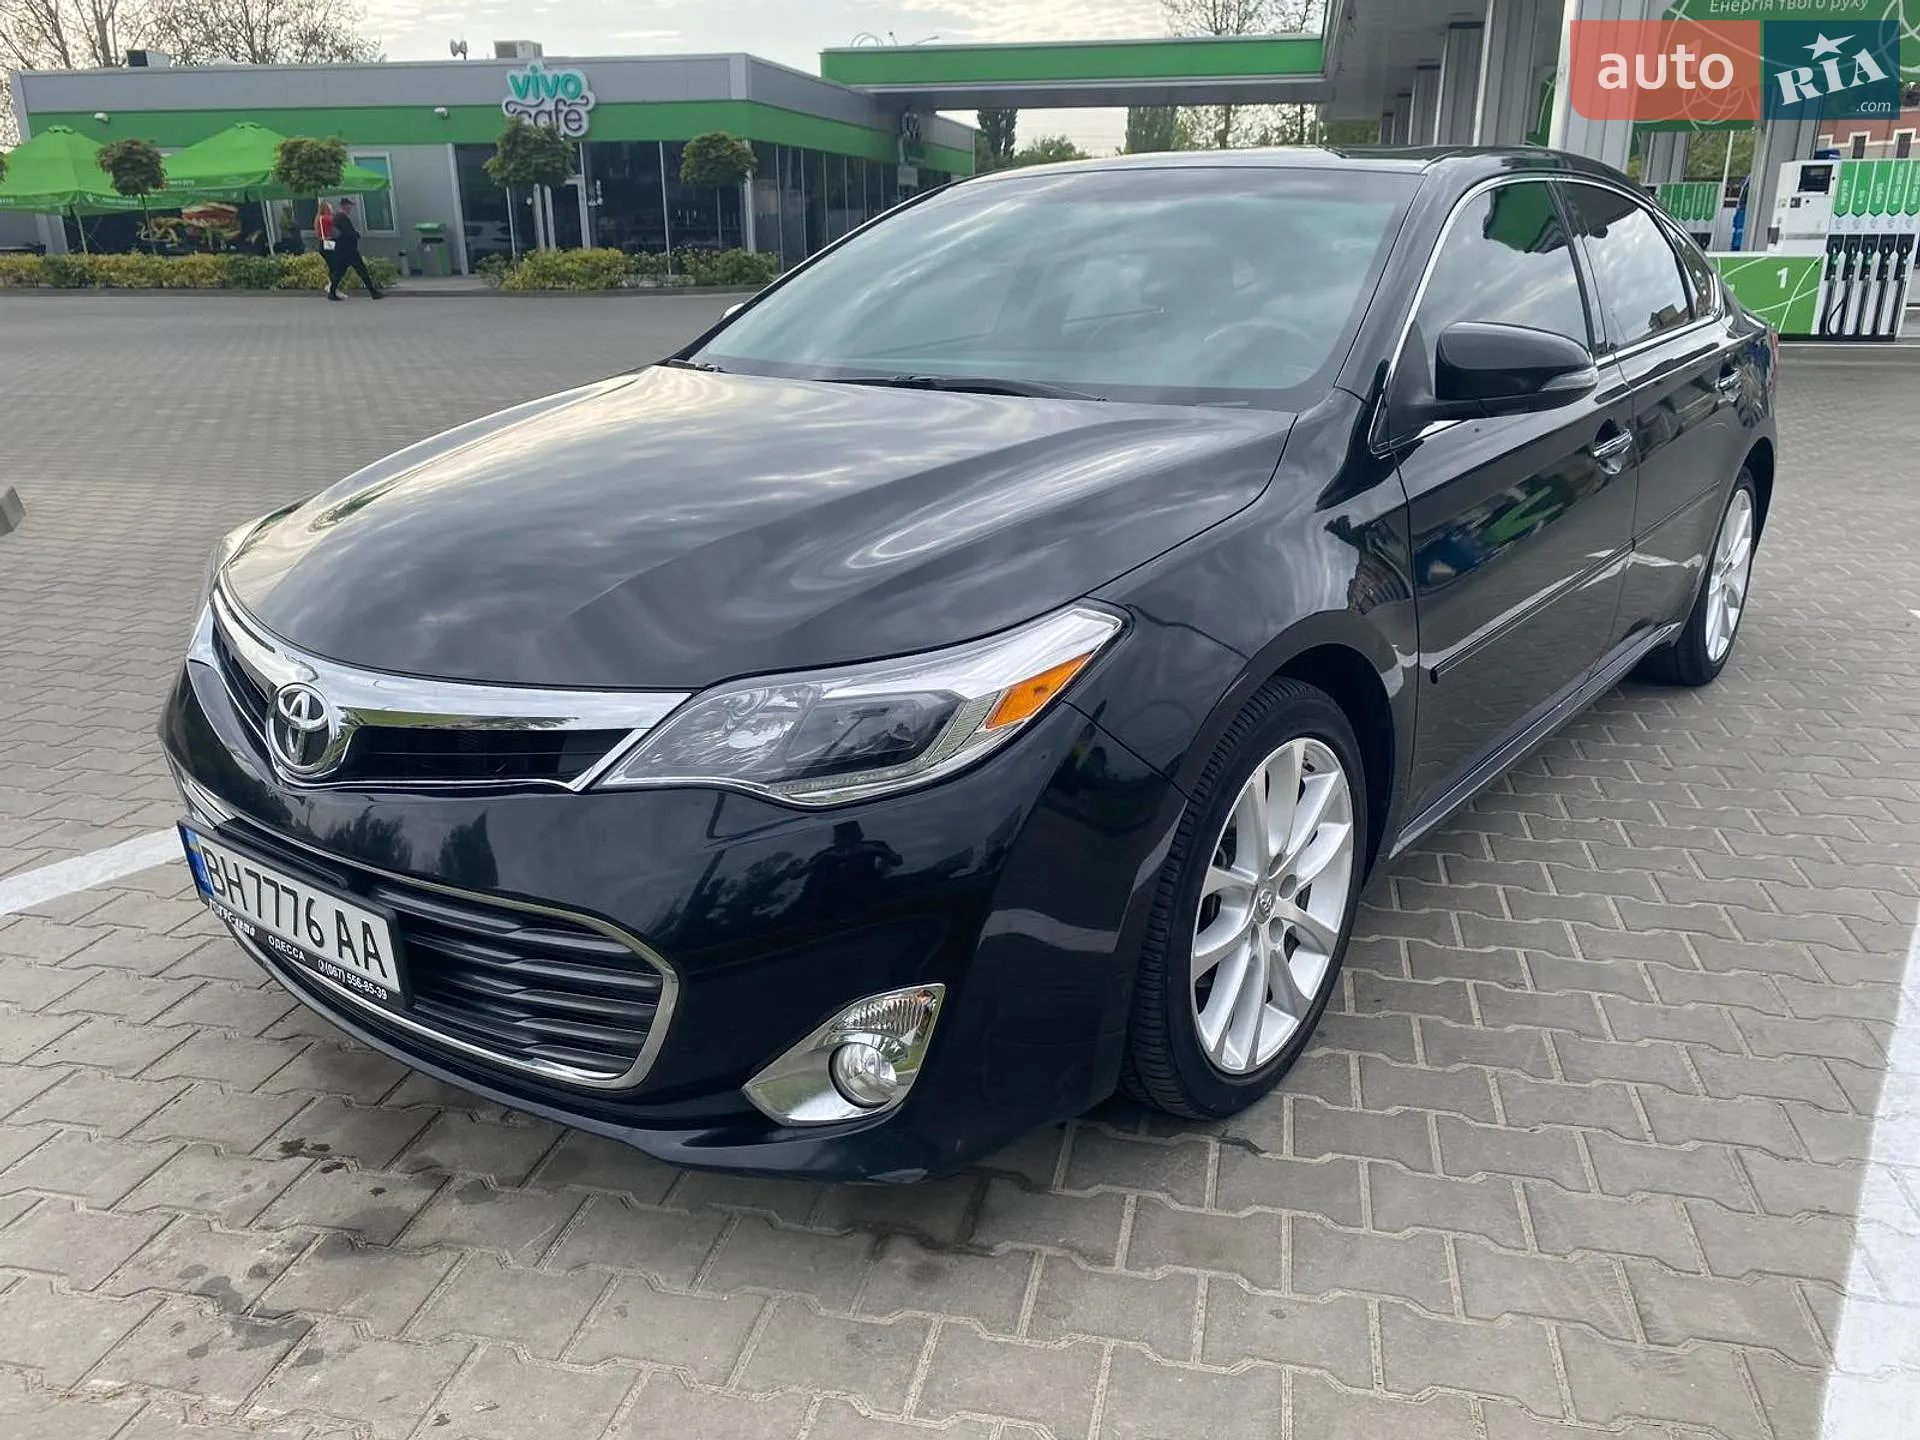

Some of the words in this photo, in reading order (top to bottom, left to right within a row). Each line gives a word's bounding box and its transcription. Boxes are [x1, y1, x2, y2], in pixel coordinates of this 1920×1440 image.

[509, 64, 582, 100] vivo
[1776, 267, 1788, 289] 1
[267, 934, 306, 962] ОДЕССА
